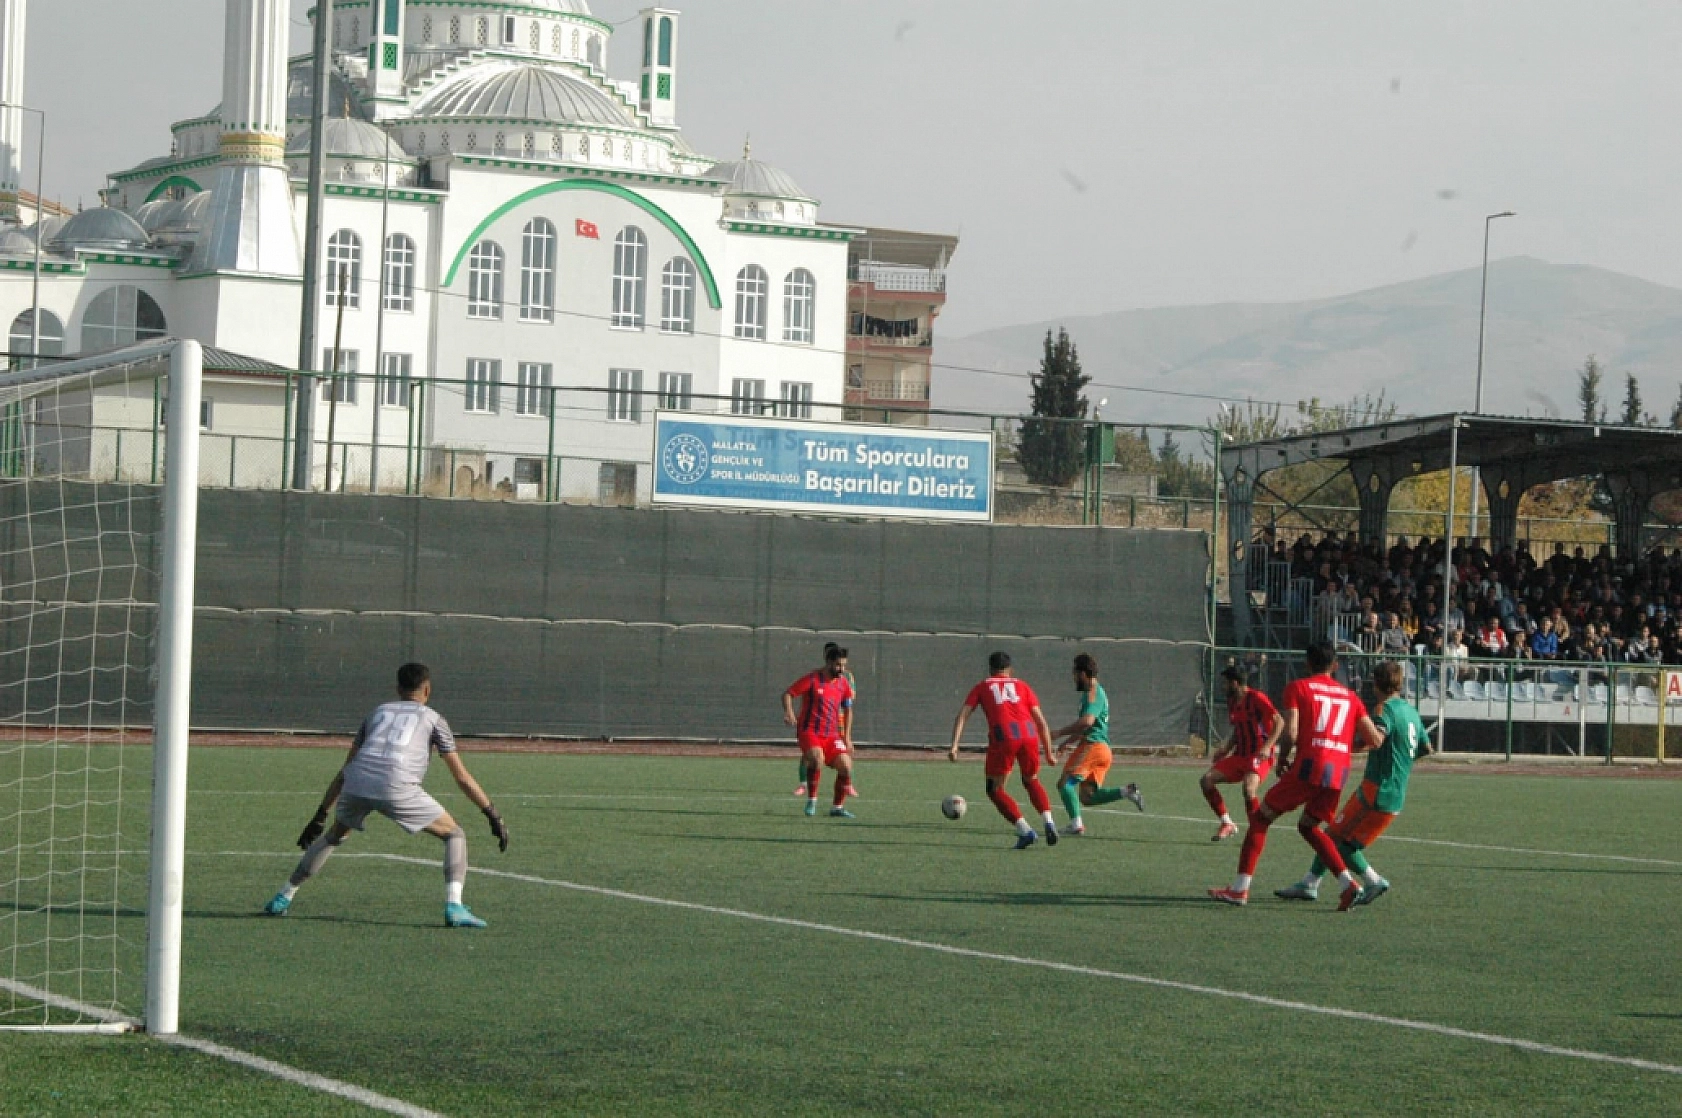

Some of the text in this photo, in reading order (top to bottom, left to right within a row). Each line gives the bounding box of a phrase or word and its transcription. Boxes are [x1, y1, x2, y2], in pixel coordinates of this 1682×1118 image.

[711, 440, 757, 452] MALATYA
[804, 440, 849, 462] Tüm
[855, 443, 969, 470] Sporculara
[752, 457, 764, 467] VE
[711, 469, 734, 480] SPOR
[804, 470, 976, 499] Başarılar Dileriz
[989, 682, 1020, 705] 14
[1667, 674, 1681, 697] A
[1313, 694, 1351, 736] 77
